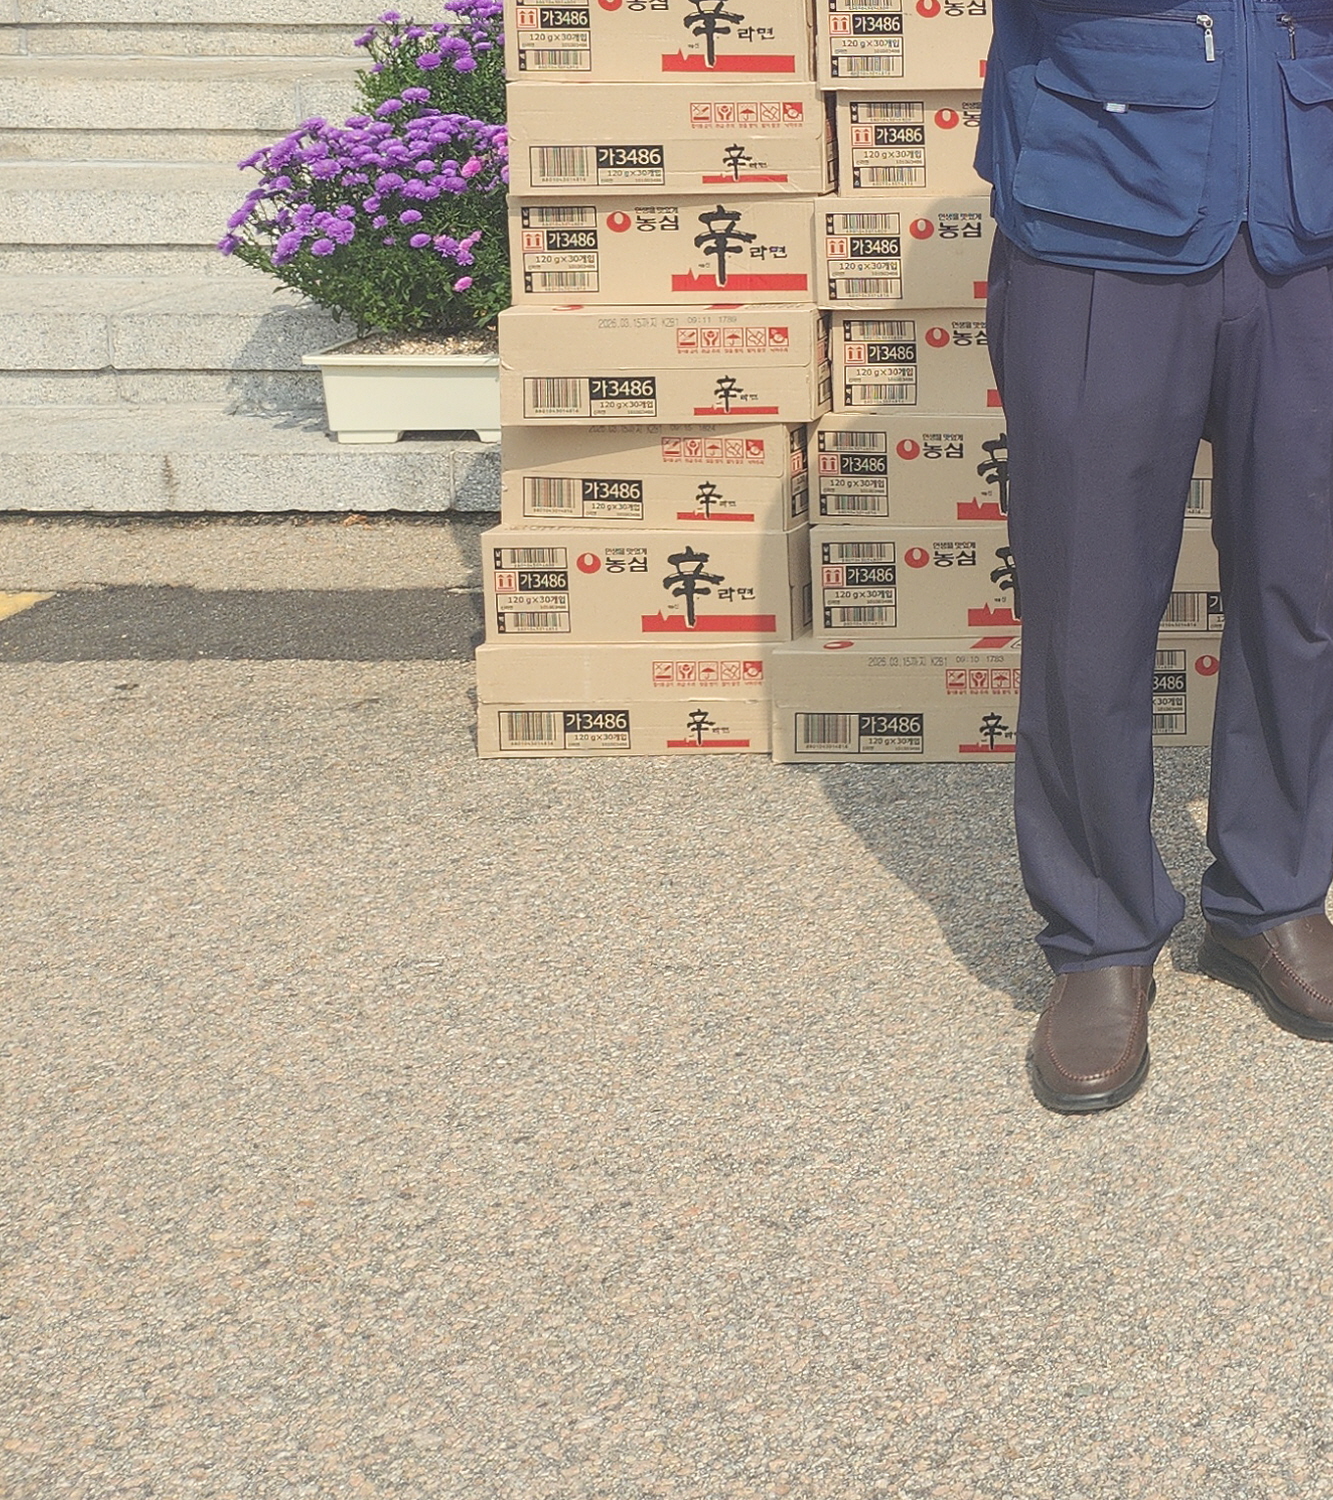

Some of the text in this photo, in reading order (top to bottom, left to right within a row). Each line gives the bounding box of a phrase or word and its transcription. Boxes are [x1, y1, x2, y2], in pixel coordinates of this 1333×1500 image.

[944, 0, 987, 16] 농심
[542, 10, 589, 26] 가3486
[855, 17, 900, 32] 가3486
[738, 26, 775, 42] 라면
[877, 128, 922, 143] 가3486
[599, 148, 661, 166] 가3486
[723, 144, 753, 181] 辛
[635, 215, 680, 231] 농심
[938, 222, 982, 238] 농심
[548, 232, 596, 248] 가3486
[695, 205, 757, 285] 辛
[853, 240, 898, 255] 가3486
[750, 245, 787, 260] 라면
[870, 346, 914, 360] 가3486
[592, 380, 654, 398] 가3486
[714, 375, 743, 413] 辛
[923, 443, 964, 459] 농심
[842, 457, 885, 473] 가3486
[585, 482, 641, 499] 가3486
[696, 481, 723, 518] 辛
[605, 556, 648, 573] 농심
[933, 551, 977, 567] 농심
[520, 573, 566, 590] 가3486
[849, 569, 893, 583] 가3486
[663, 546, 725, 626] 辛
[718, 587, 756, 601] 라면
[566, 714, 628, 731] 가3486
[687, 709, 715, 746] 辛
[861, 717, 921, 733] 가3486
